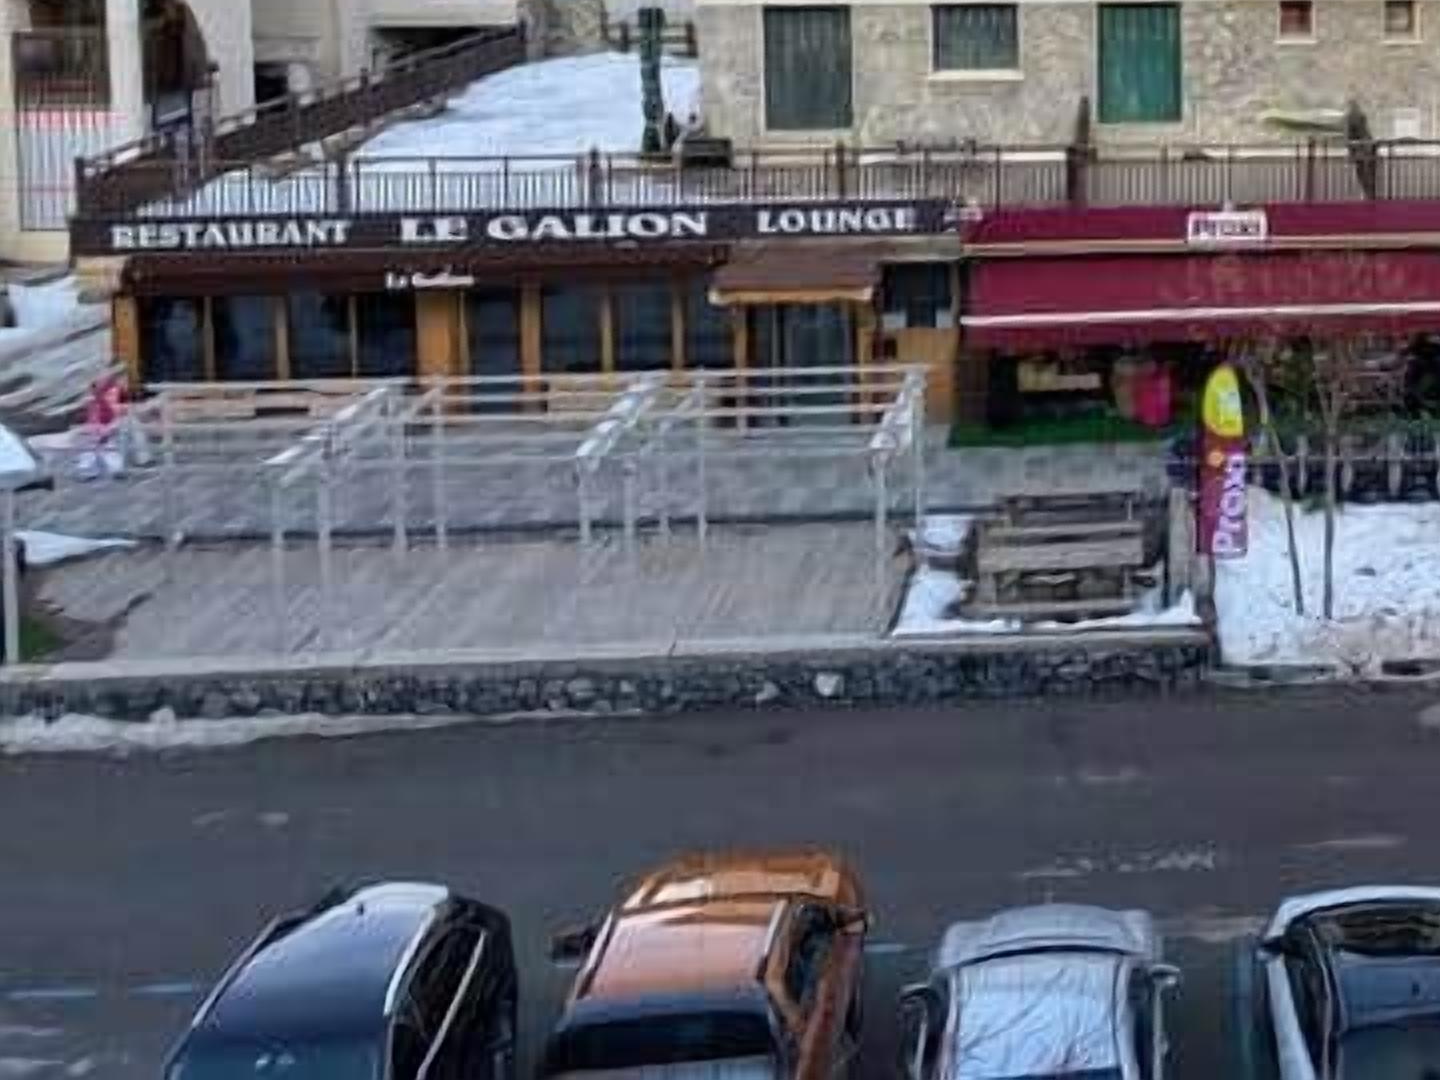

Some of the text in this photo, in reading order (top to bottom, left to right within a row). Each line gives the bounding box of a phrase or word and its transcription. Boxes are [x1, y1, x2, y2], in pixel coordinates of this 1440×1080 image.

[111, 206, 916, 249] RESTAURANT LE GALION LOUNGE
[1211, 453, 1246, 553] Proxi
